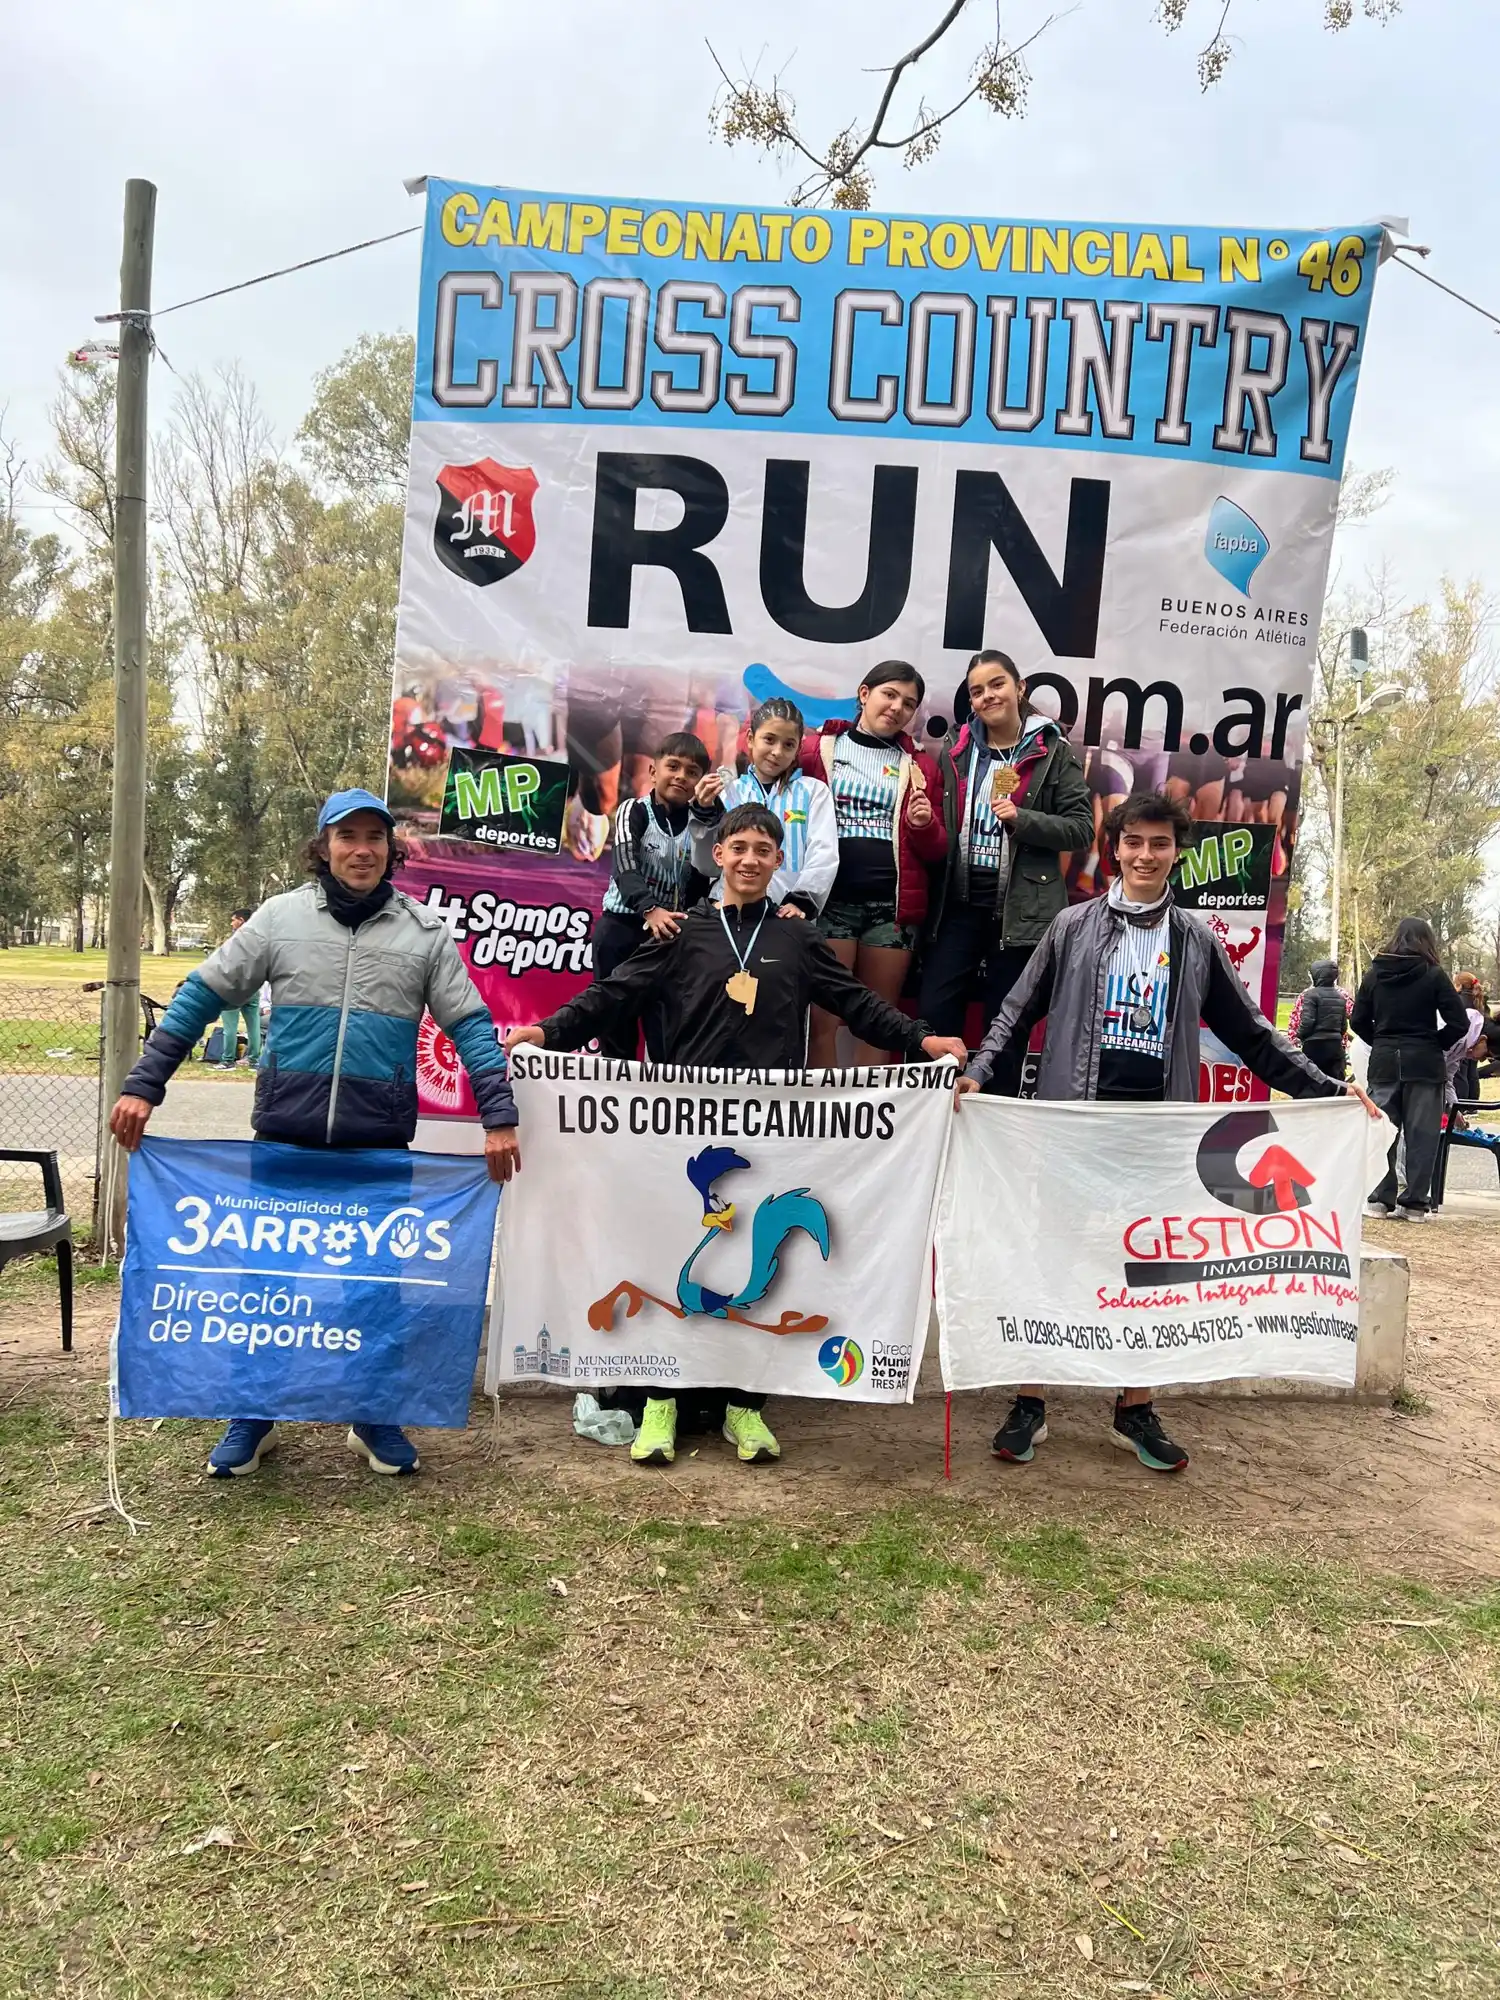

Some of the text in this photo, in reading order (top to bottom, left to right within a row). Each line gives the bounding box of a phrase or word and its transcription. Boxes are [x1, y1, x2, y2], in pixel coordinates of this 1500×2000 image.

[441, 191, 832, 265] CAMPEONATO
[847, 217, 1205, 283] PROVINCIAL
[1298, 235, 1366, 297] 46
[431, 270, 1360, 464] CROSS COUNTRY
[473, 545, 498, 557] 1933
[587, 451, 1112, 659] RUN
[1213, 530, 1259, 553] fapba
[1161, 598, 1310, 628] BUENOS AIRES
[1159, 618, 1307, 647] Federación Atlética
[455, 762, 541, 820] MP
[475, 825, 558, 850] deportes
[1180, 828, 1254, 890] MP
[1198, 892, 1265, 910] deportes
[510, 1054, 632, 1082] SCUELITA
[639, 1061, 777, 1087] MUNICIPAL
[784, 1067, 814, 1088] DE
[559, 1094, 896, 1141] LOS CORRECAMINOS
[215, 1194, 369, 1217] Municipalidad de
[1123, 1209, 1344, 1260] GESTION
[1202, 1253, 1349, 1278] INMOBILIARIA
[151, 1282, 312, 1317] Dirección
[1096, 1286, 1190, 1310] Solución
[1196, 1274, 1279, 1306] Integral
[1285, 1274, 1307, 1295] de
[149, 1314, 362, 1355] de Deportes
[997, 1316, 1023, 1343] Tel.
[1024, 1318, 1113, 1350] 02983-426763
[1123, 1327, 1151, 1349] Cel.
[1154, 1316, 1243, 1349] 2983-457825
[574, 1366, 680, 1379] DE TRES ARROYOS
[577, 1355, 677, 1367] MUNICIPALIDAD
[871, 1378, 895, 1390] TRES
